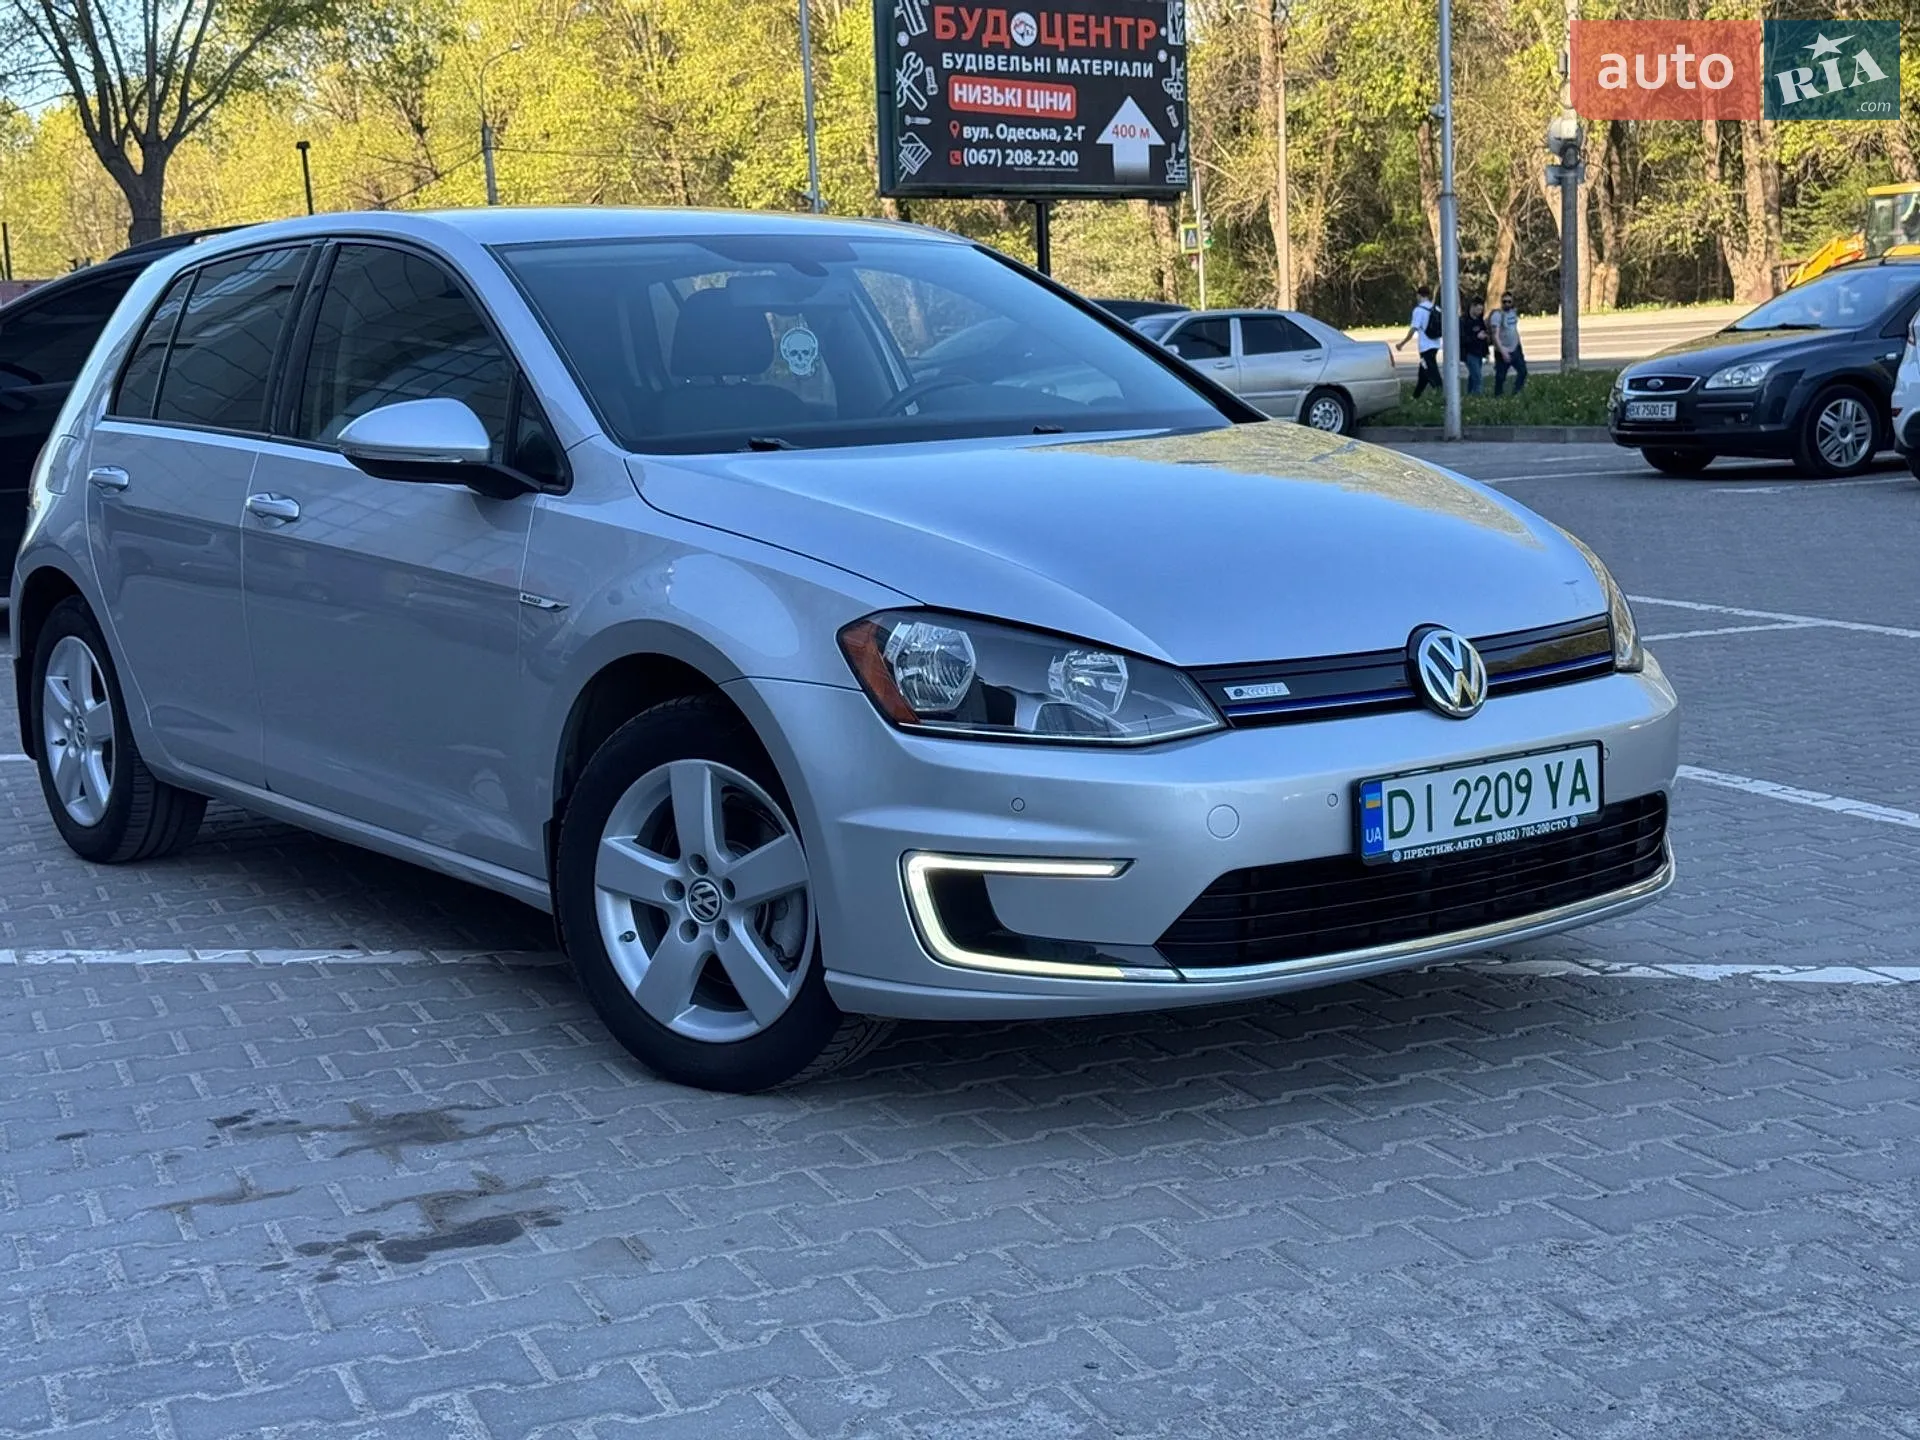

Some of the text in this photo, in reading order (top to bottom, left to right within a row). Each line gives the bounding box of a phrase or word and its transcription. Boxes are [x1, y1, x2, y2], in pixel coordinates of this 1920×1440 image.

[942, 52, 1154, 78] БУДІВЕЛЬНІ МАТЕРІАЛИ
[953, 83, 1072, 113] НИЗЬКІ ЦІНИ
[962, 123, 1086, 143] вул. Одеська, 2-Г
[1111, 124, 1136, 138] 400
[963, 149, 1079, 168] (067) 208-22-00
[1660, 403, 1674, 416] ET
[1387, 758, 1591, 840] DI 2209 YA
[1365, 827, 1382, 844] UA
